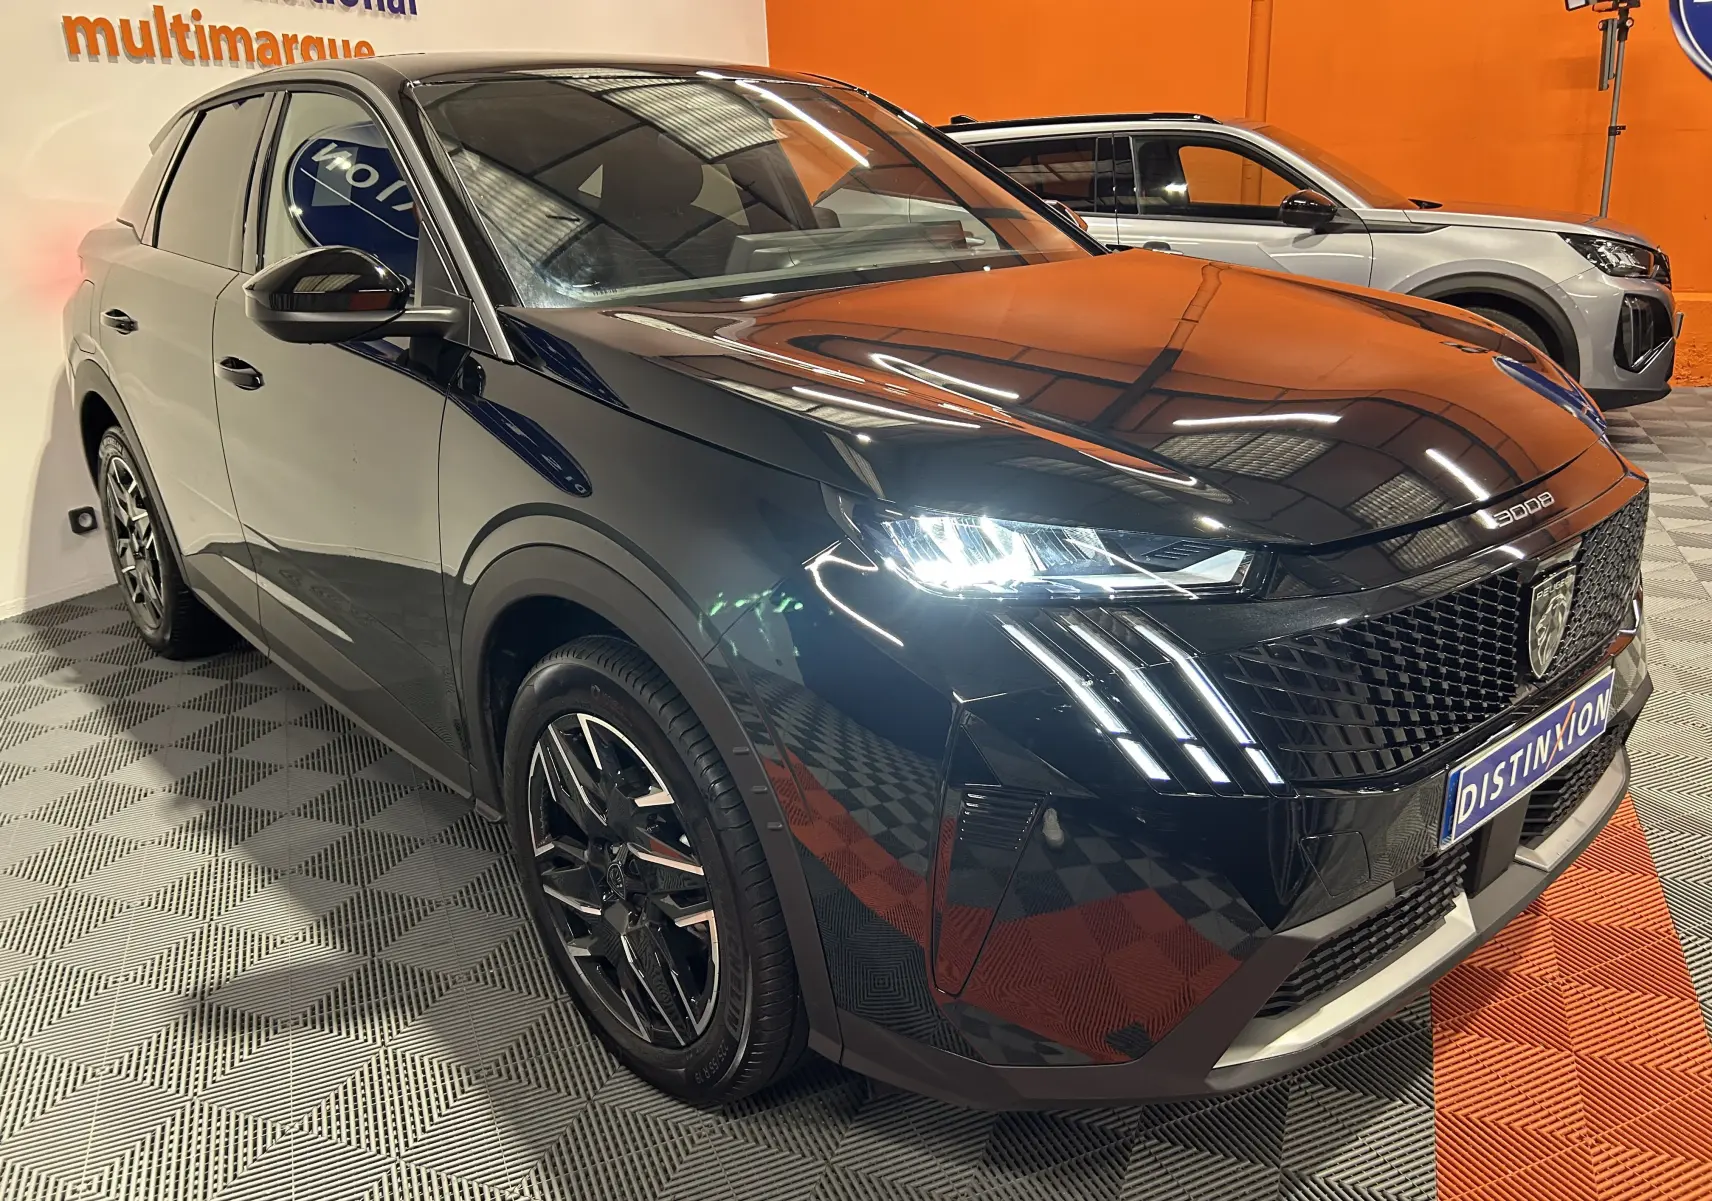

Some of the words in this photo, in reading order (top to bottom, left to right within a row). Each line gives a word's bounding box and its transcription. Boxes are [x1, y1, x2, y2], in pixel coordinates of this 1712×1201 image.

[1493, 491, 1555, 528] 3008
[1536, 576, 1572, 601] PEUGE
[1458, 689, 1610, 823] DISTINXION
